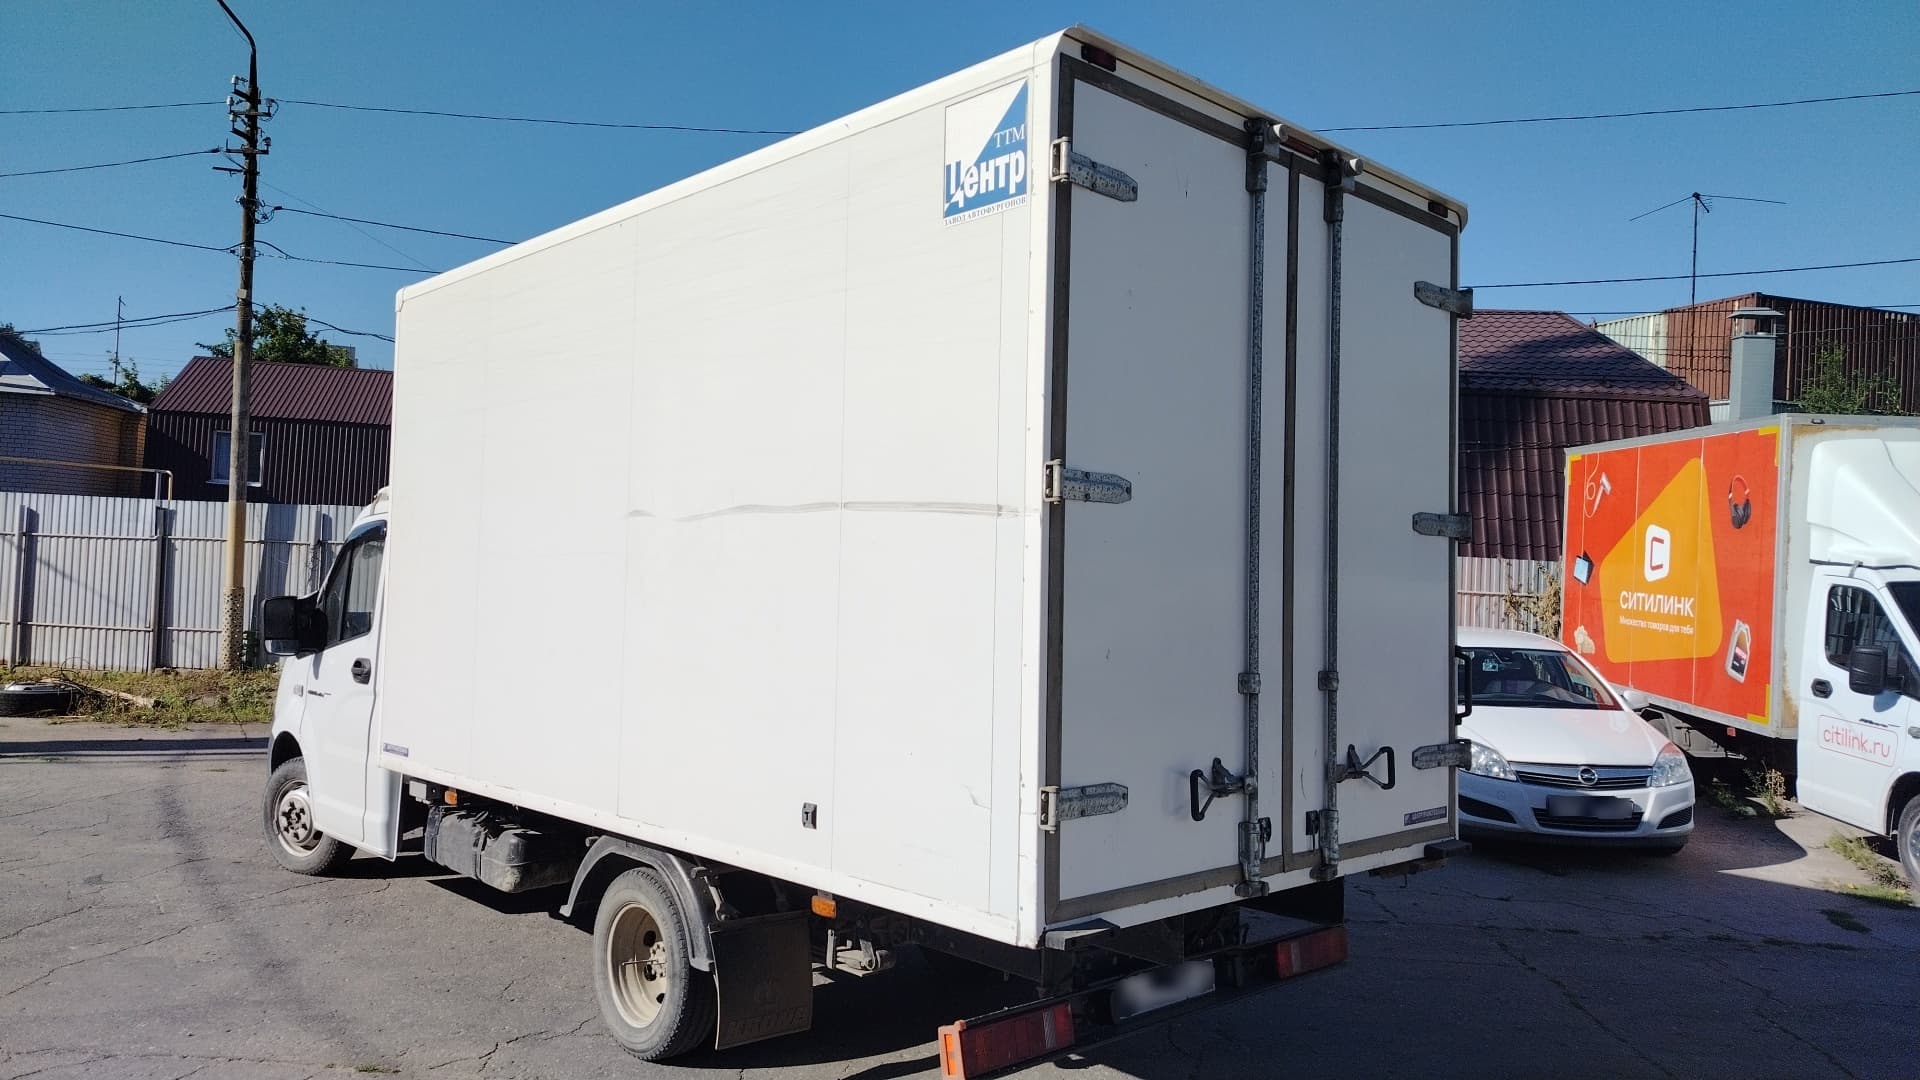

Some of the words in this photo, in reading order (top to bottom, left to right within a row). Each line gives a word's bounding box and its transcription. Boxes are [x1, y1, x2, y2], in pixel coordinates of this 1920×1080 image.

[994, 124, 1025, 148] ТТМ
[946, 150, 1025, 208] Центр
[1620, 590, 1694, 617] СИТИЛИНК
[1823, 725, 1890, 758] citilink.ru
